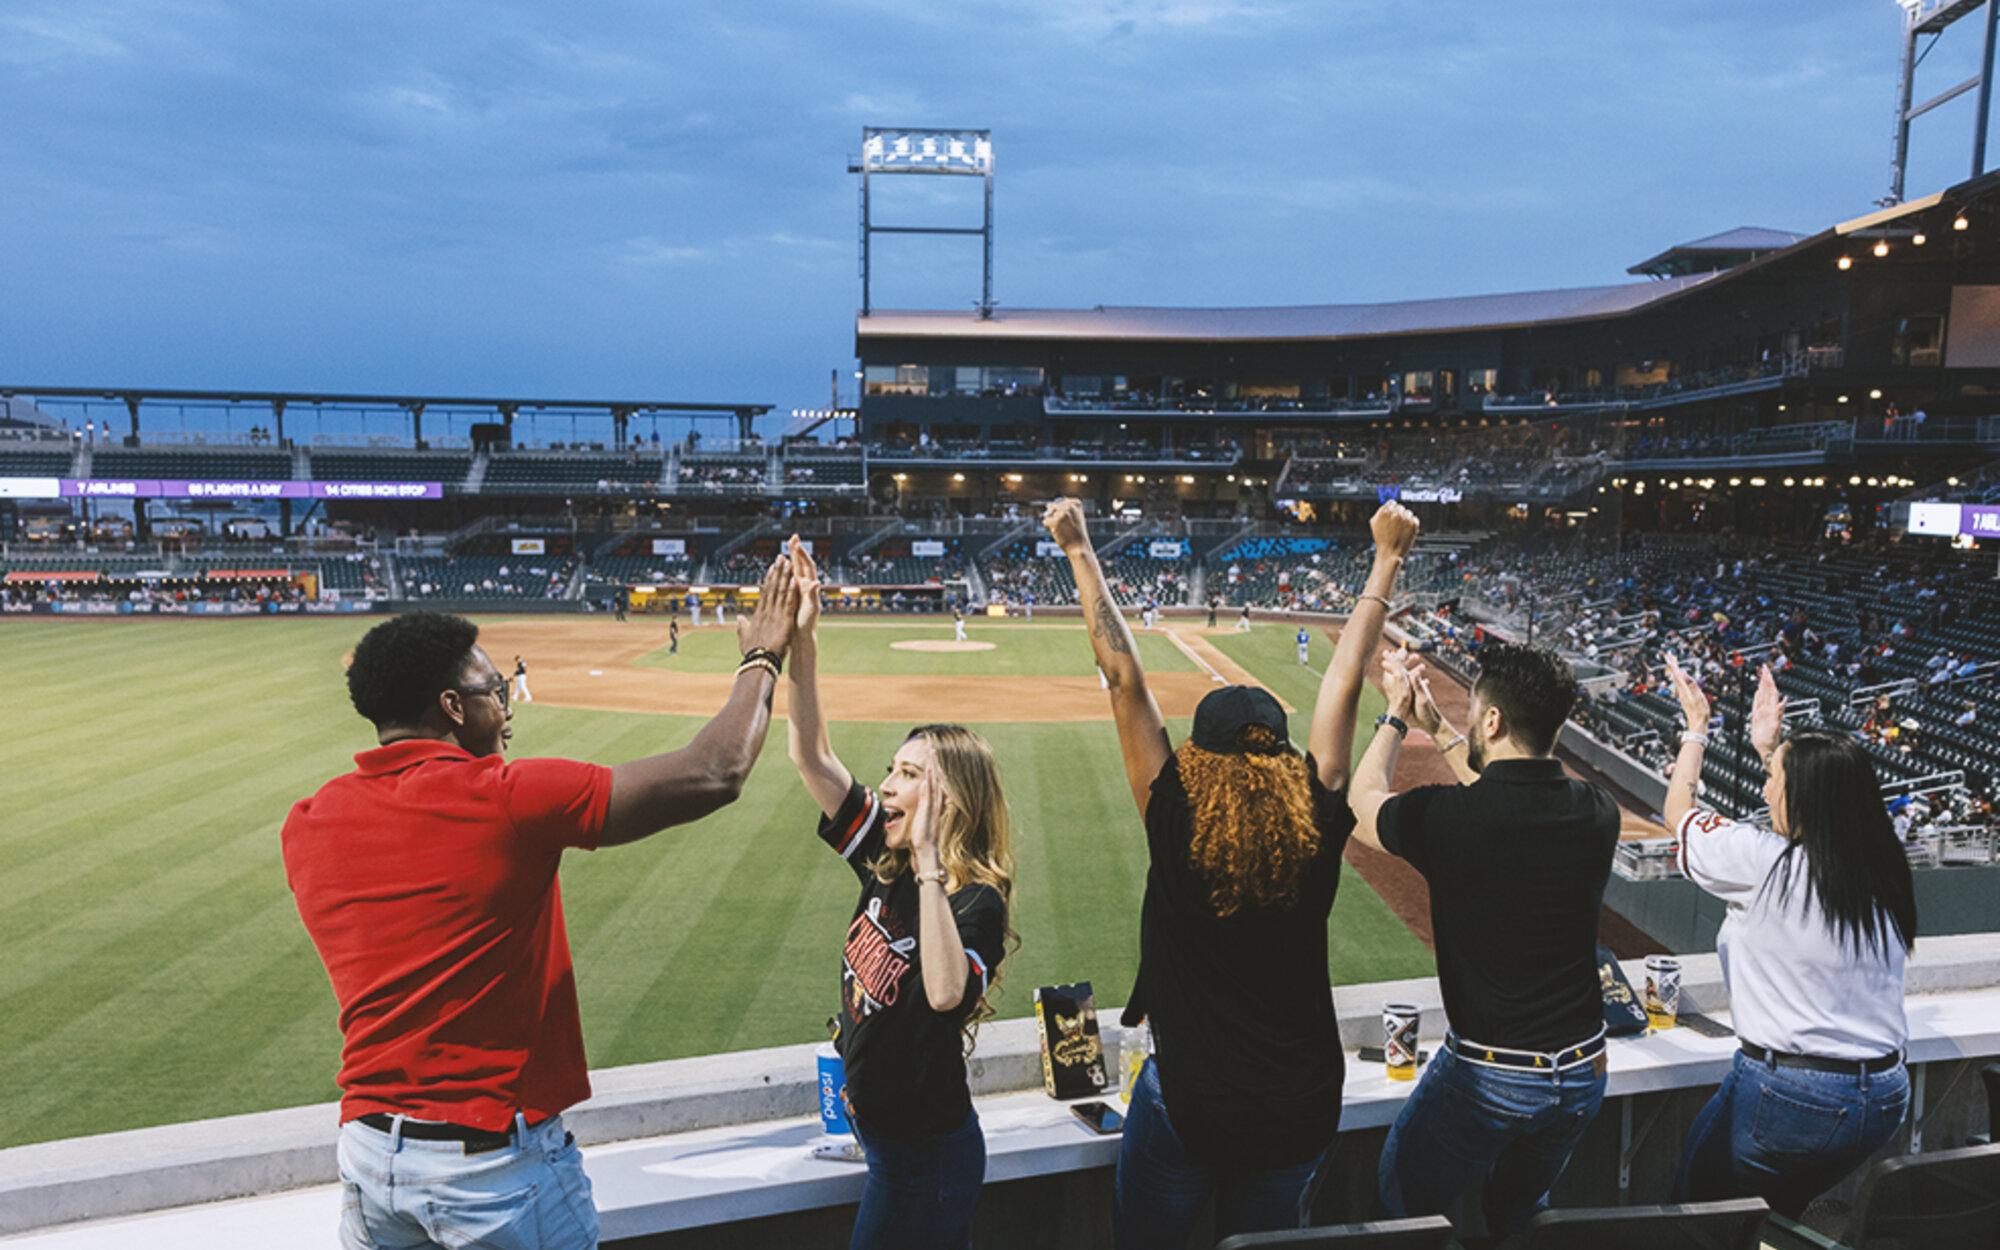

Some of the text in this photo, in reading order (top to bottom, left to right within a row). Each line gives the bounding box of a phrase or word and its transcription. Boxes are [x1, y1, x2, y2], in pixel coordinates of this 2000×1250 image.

[77, 483, 136, 494] 7 AIRLINES
[204, 483, 249, 495] FLIGHTS
[251, 484, 259, 494] A
[260, 484, 282, 495] DAY
[325, 484, 427, 496] 14 CITIES NON STOP
[1972, 513, 1981, 531] 7
[820, 1071, 838, 1120] pepsi
